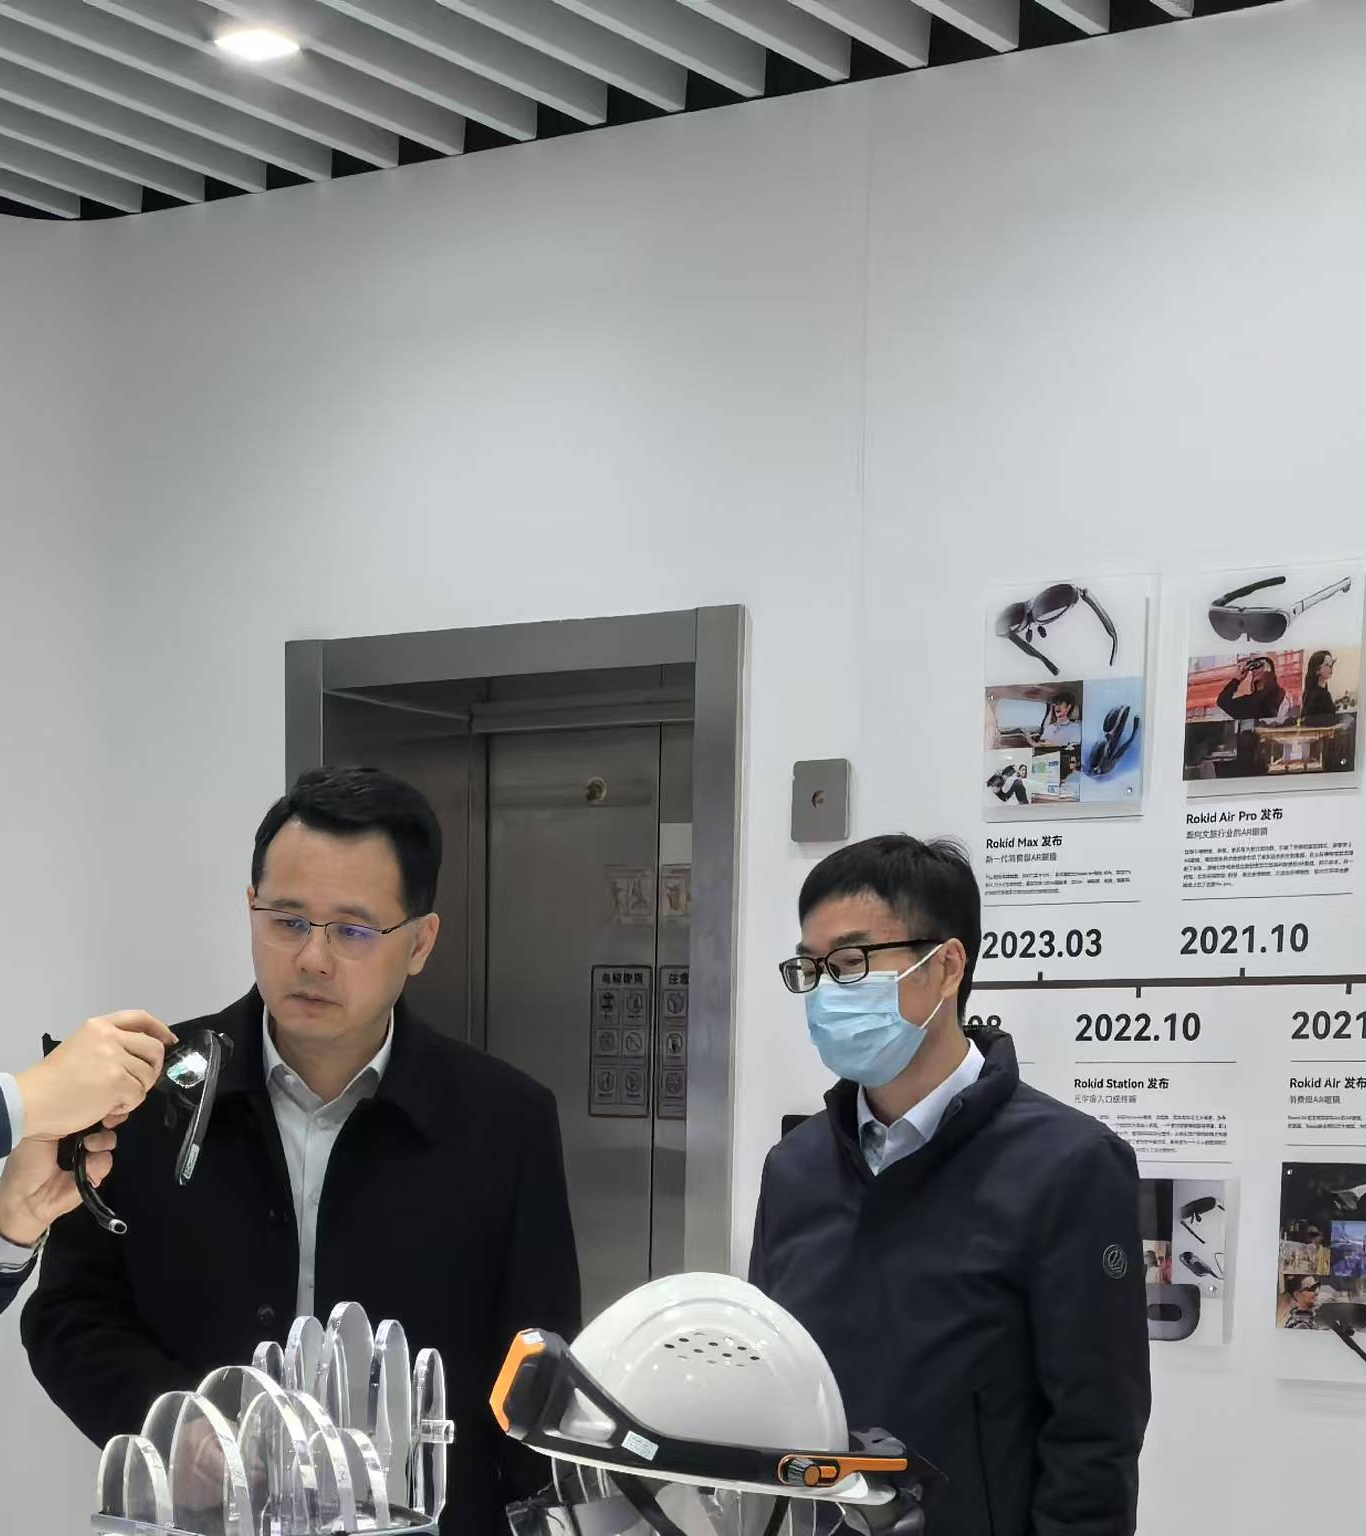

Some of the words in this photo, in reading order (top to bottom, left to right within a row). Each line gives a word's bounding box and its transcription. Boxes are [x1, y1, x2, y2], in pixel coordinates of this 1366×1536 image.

[1187, 814, 1217, 824] Rokid
[1219, 812, 1236, 823] Air
[1239, 810, 1257, 822] Pro
[1261, 808, 1283, 821] 发布
[986, 838, 1015, 849] Rokid
[1018, 836, 1038, 848] Max
[1041, 835, 1063, 847] 发布
[982, 929, 1102, 959] 2023.03
[1180, 923, 1309, 955] 2021.10
[1075, 1012, 1201, 1042] 2022.10
[1074, 1078, 1103, 1089] Rokid
[1106, 1078, 1145, 1089] Station
[1147, 1078, 1169, 1089] 发布
[1290, 1077, 1321, 1088] Rokid
[1324, 1077, 1341, 1088] Air
